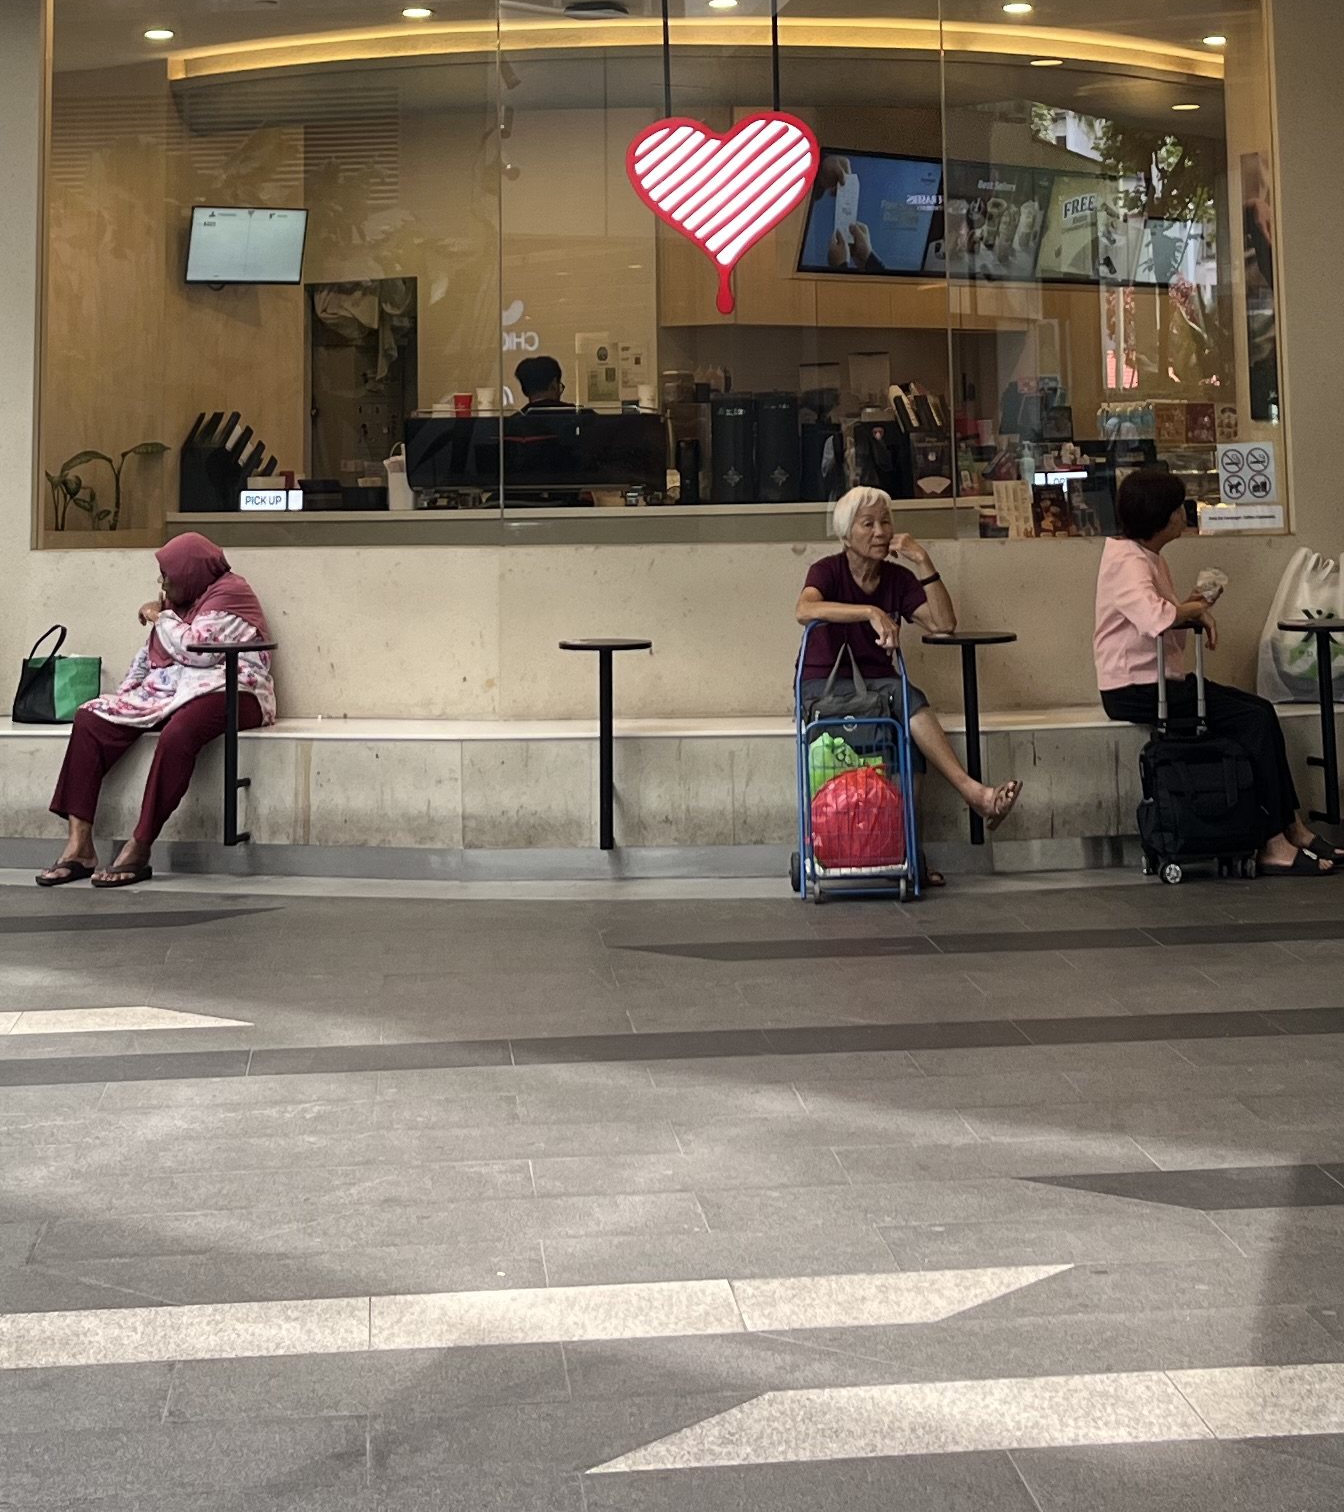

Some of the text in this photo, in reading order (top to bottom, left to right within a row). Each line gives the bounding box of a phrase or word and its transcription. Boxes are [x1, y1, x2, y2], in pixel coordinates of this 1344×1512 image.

[1063, 195, 1095, 219] FREE
[245, 495, 282, 506] PICK UP
